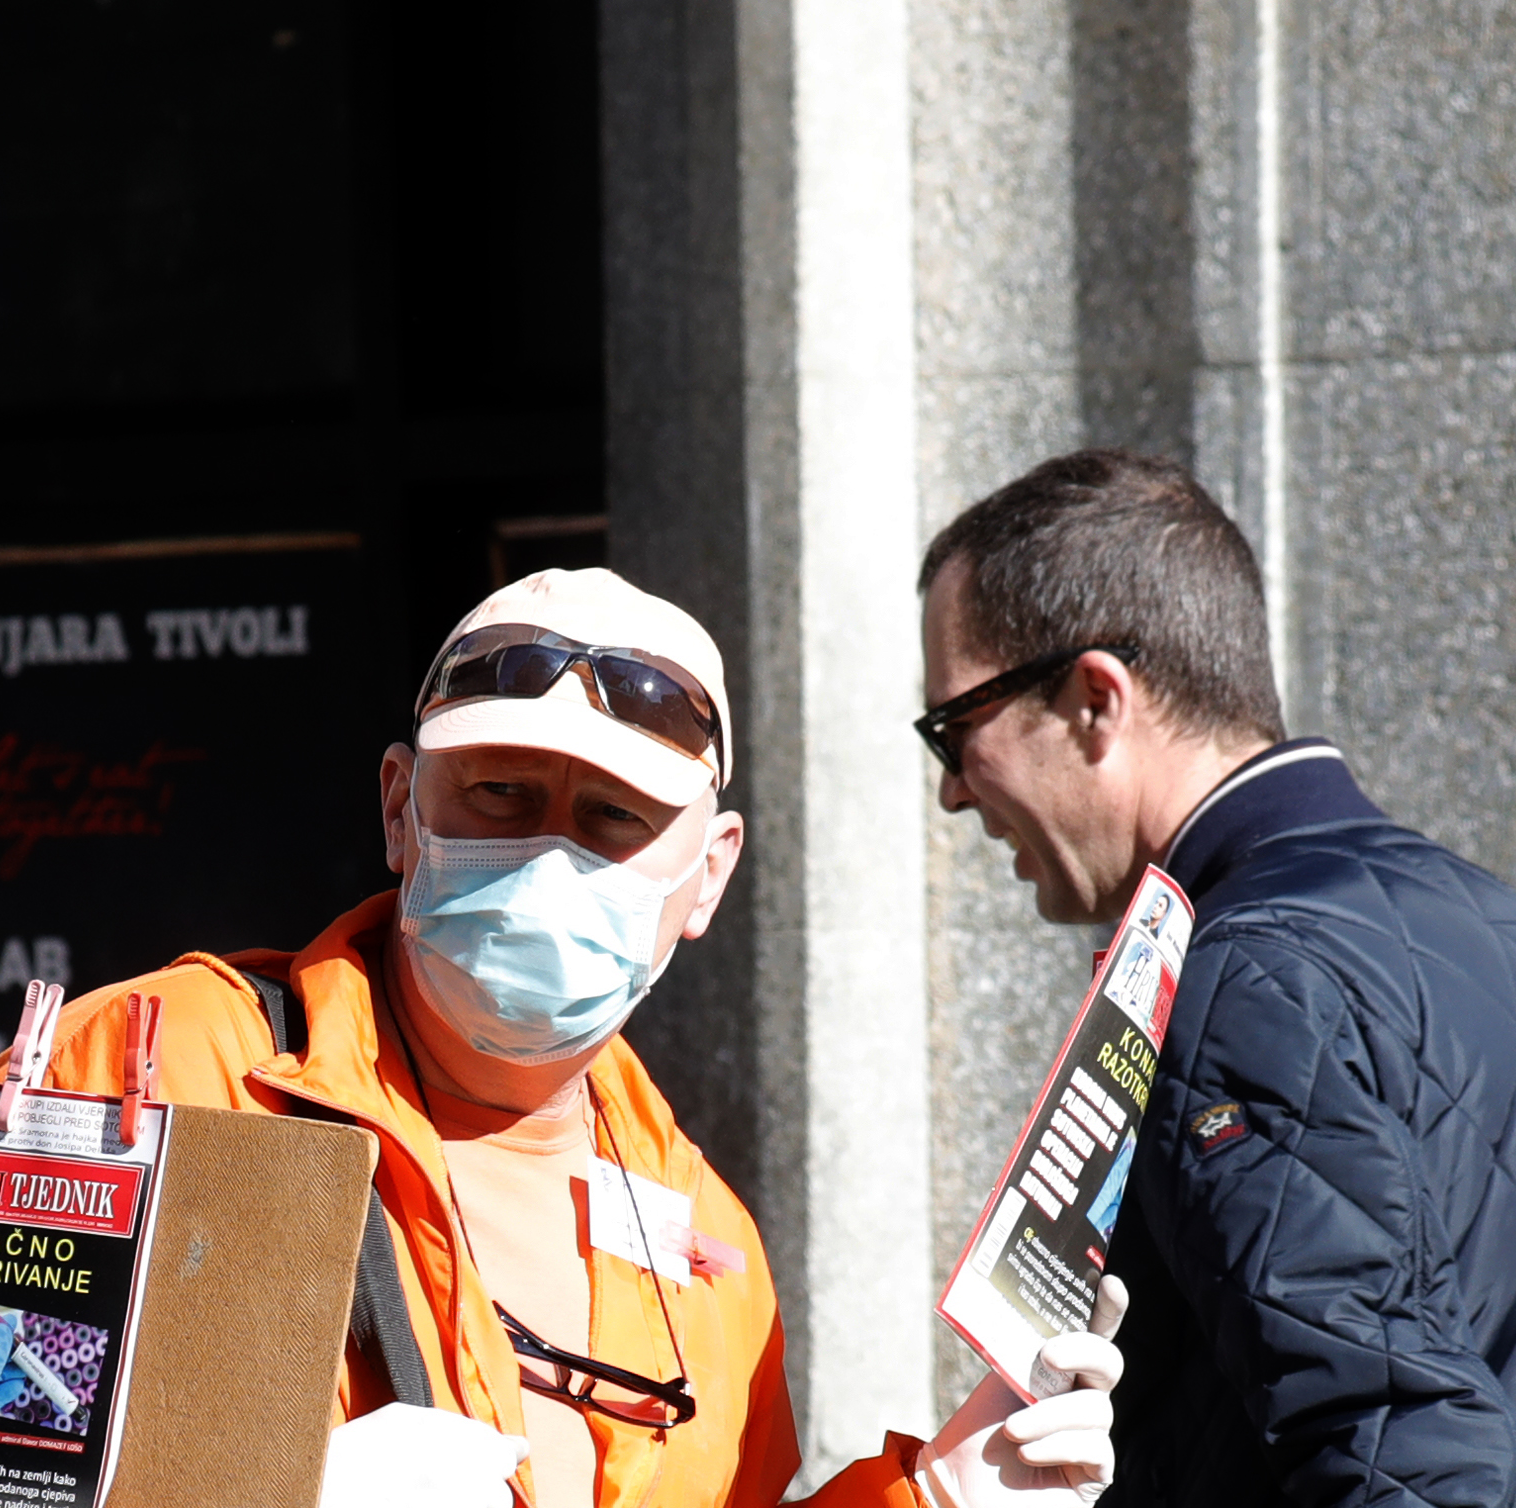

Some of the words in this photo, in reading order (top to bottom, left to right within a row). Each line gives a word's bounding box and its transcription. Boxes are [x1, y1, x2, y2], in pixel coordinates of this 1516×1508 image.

[146, 604, 311, 661] TIVOLI
[11, 1173, 119, 1219] TJEDNIK
[9, 1469, 20, 1479] na
[23, 1471, 52, 1485] zemlji
[54, 1475, 76, 1486] kako
[41, 1490, 76, 1503] cjepiva
